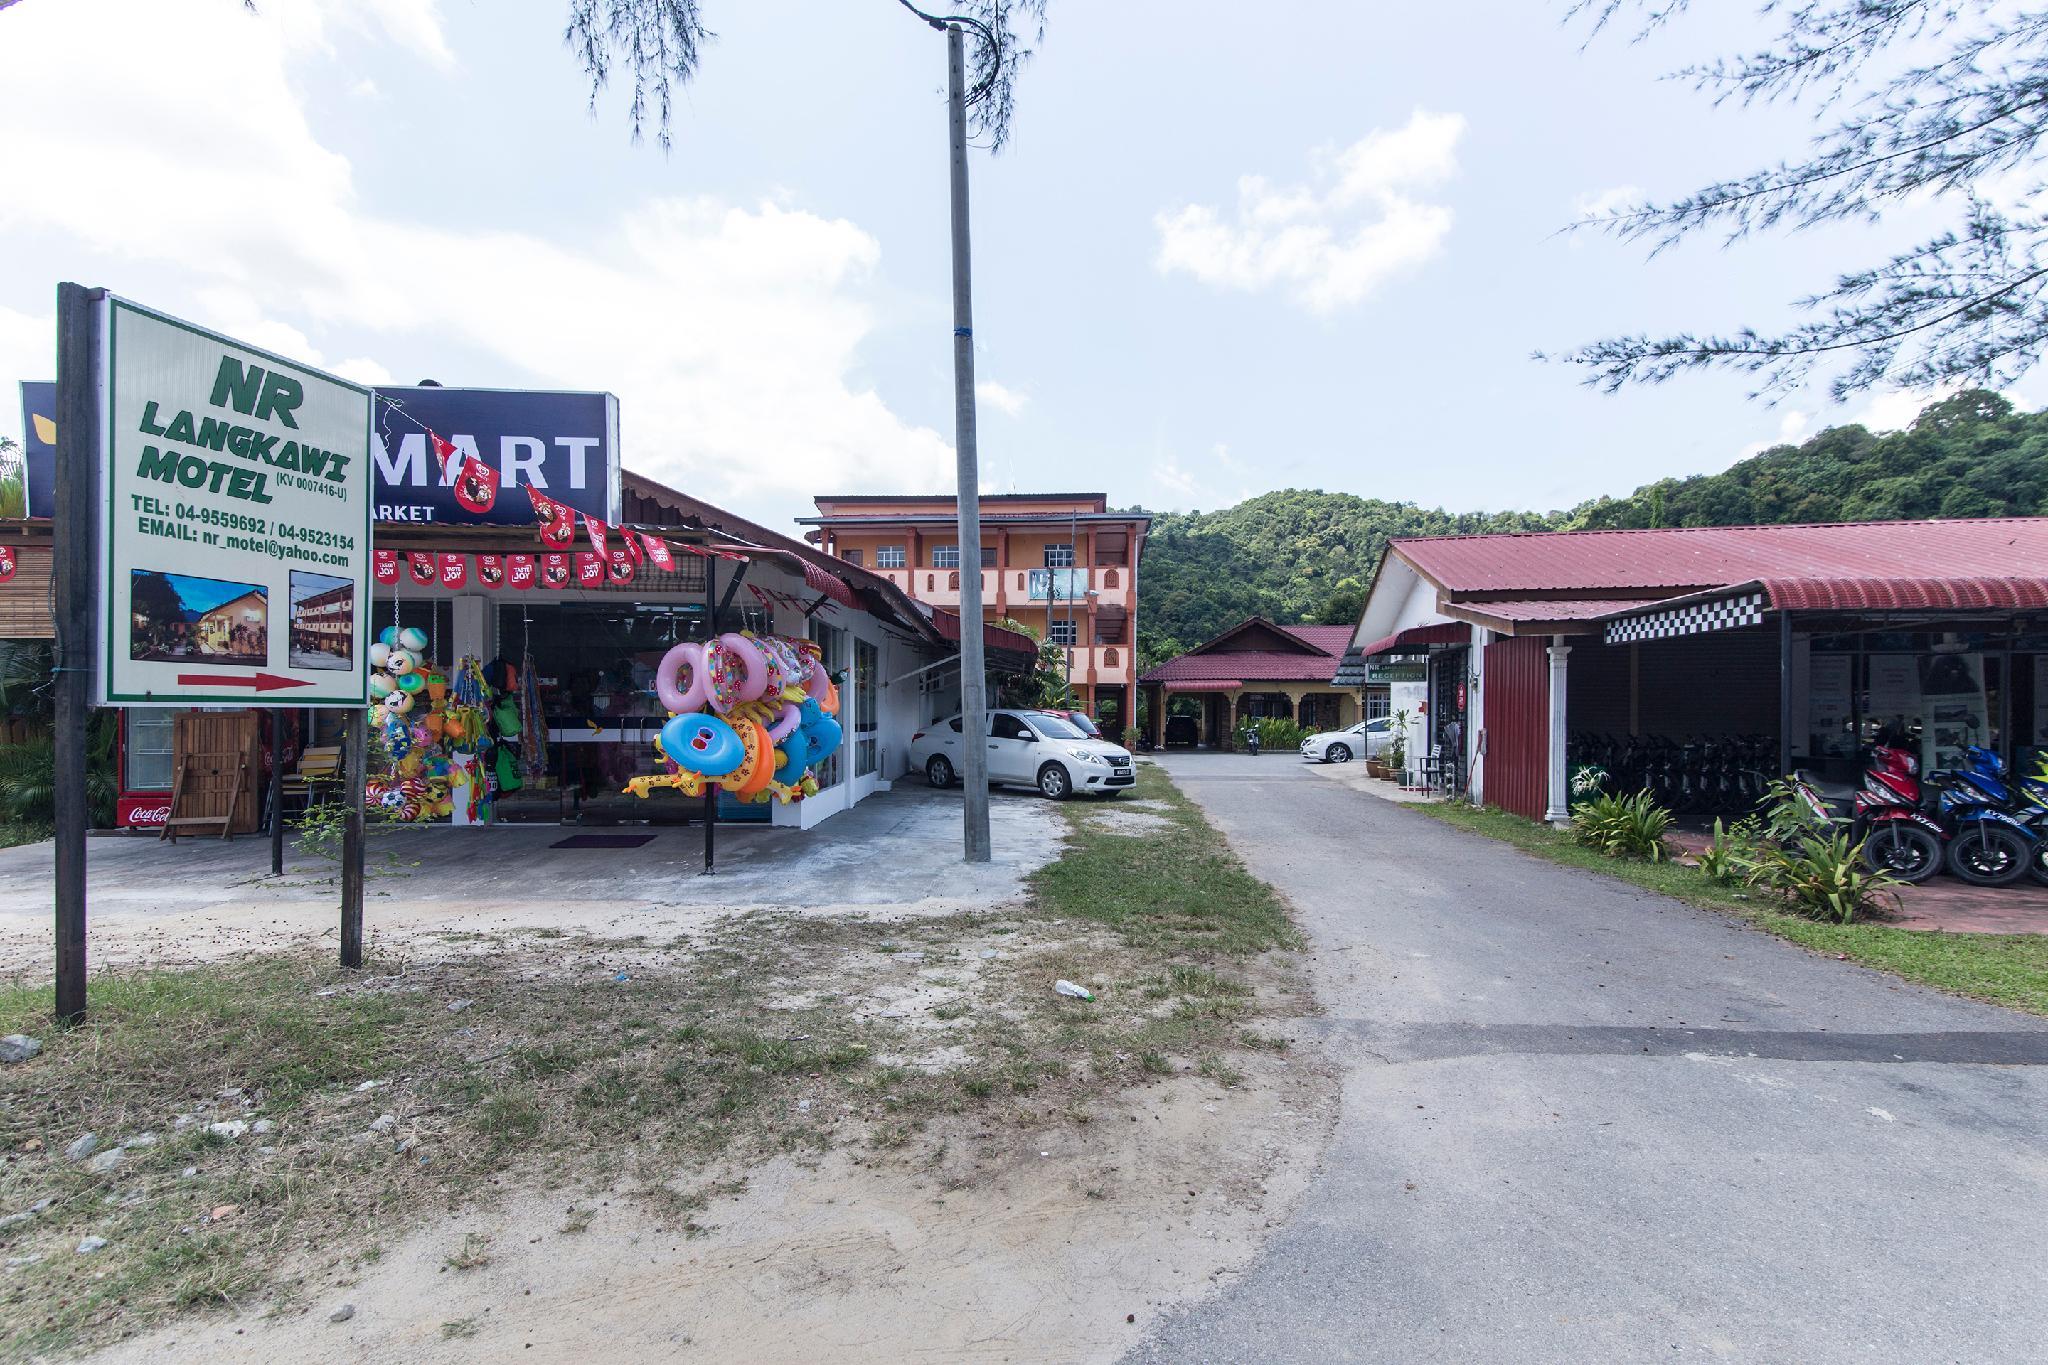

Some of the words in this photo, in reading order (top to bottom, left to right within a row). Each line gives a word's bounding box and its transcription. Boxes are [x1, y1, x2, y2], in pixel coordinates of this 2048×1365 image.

[210, 355, 303, 430] NR
[139, 401, 351, 483] LANGKAWI
[373, 433, 600, 489] MART
[137, 445, 273, 504] MOTEL
[276, 472, 295, 488] (KV
[296, 477, 347, 503] 0007416-U)
[131, 494, 170, 517] TEL:
[175, 503, 266, 535] 04-9559692
[269, 521, 275, 536] /
[278, 523, 355, 551] 04-9523154
[138, 517, 198, 542] EMAIL:
[202, 531, 349, 568] nr_motel@yahoo.com
[129, 806, 170, 822] Coca-Col
